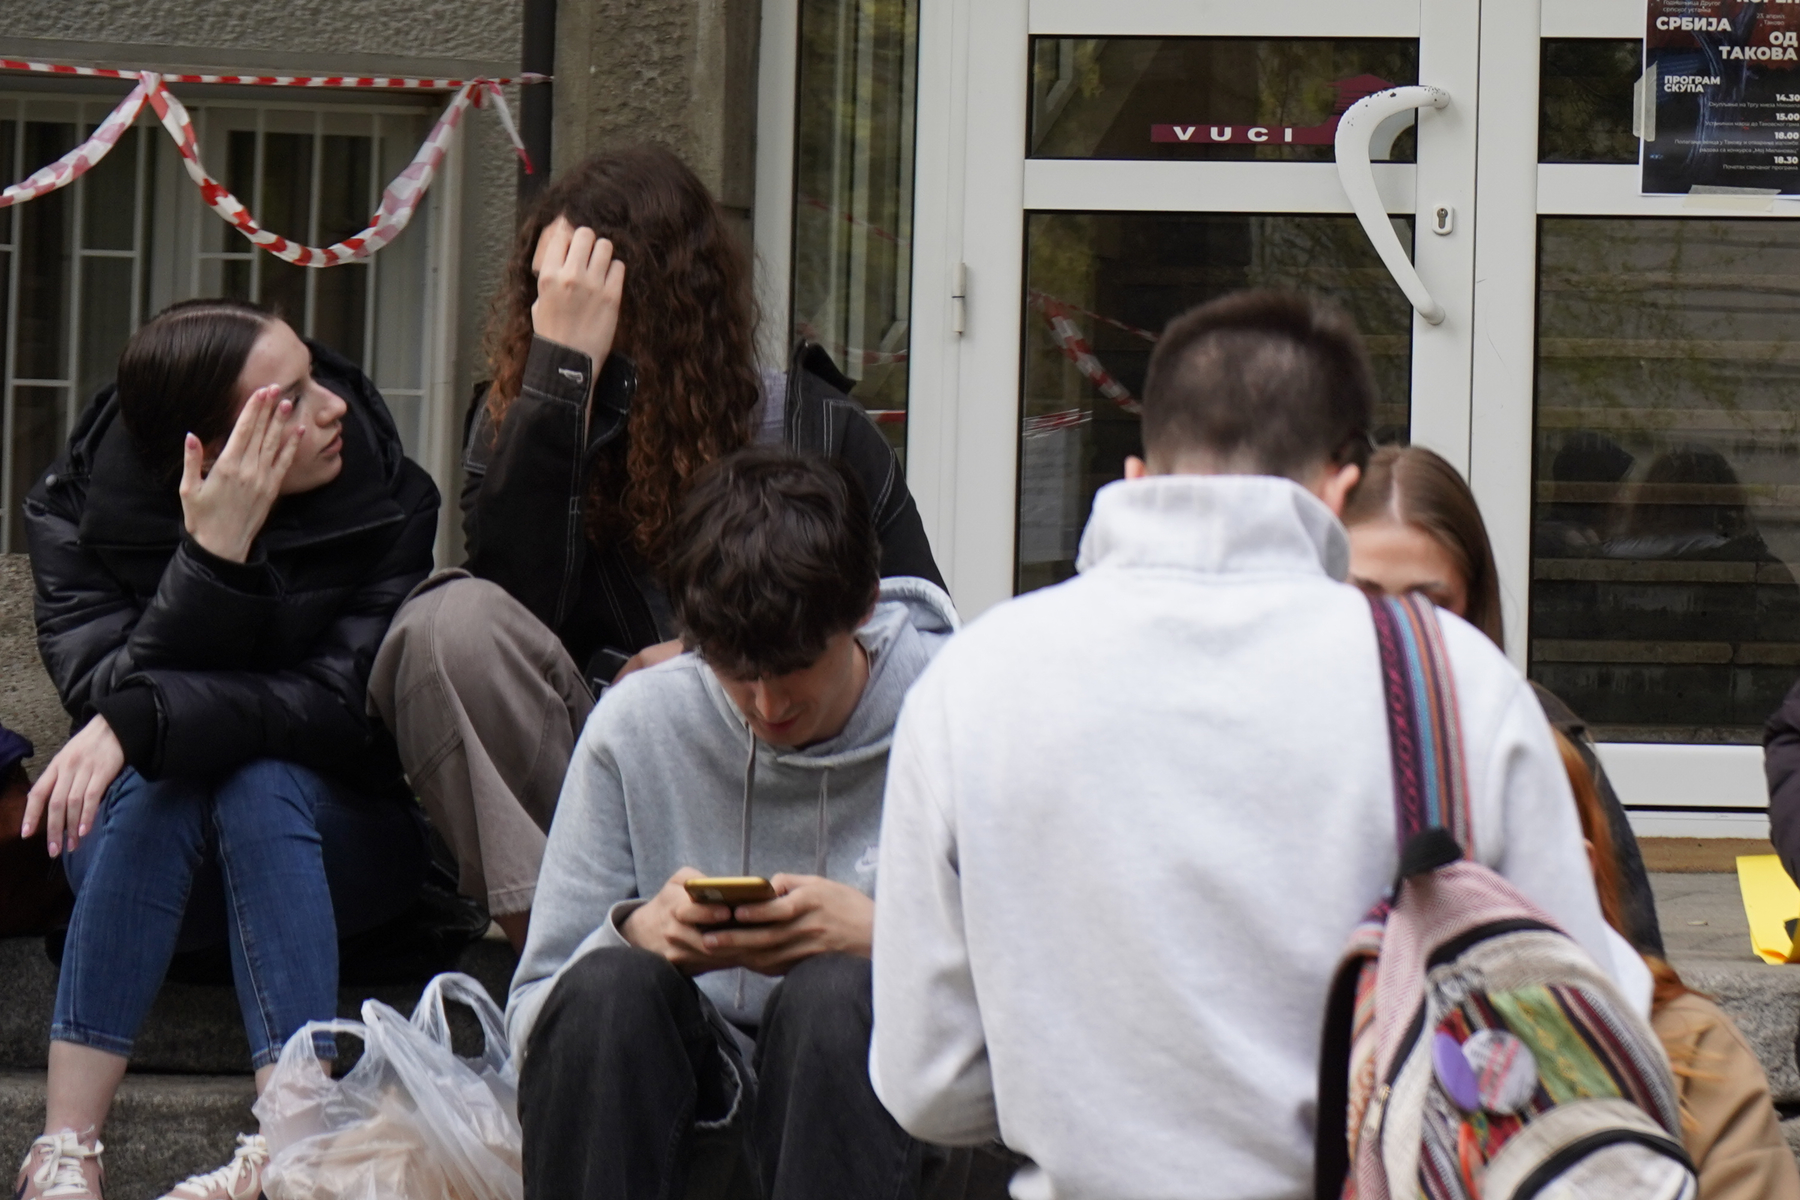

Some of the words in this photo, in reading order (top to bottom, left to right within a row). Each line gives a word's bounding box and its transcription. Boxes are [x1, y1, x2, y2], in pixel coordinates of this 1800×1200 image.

[1656, 16, 1732, 32] СРБИЈА
[1769, 31, 1798, 47] ОД
[1718, 46, 1798, 60] ТАКОВА
[1664, 75, 1720, 85] ПРОГРАМ
[1663, 84, 1704, 93] СКУПА
[1775, 94, 1800, 102] 14.30
[1775, 113, 1800, 121] 15.00
[1173, 126, 1293, 142] VUCI
[1774, 132, 1799, 140] 18.00
[1773, 156, 1799, 164] 18.30
